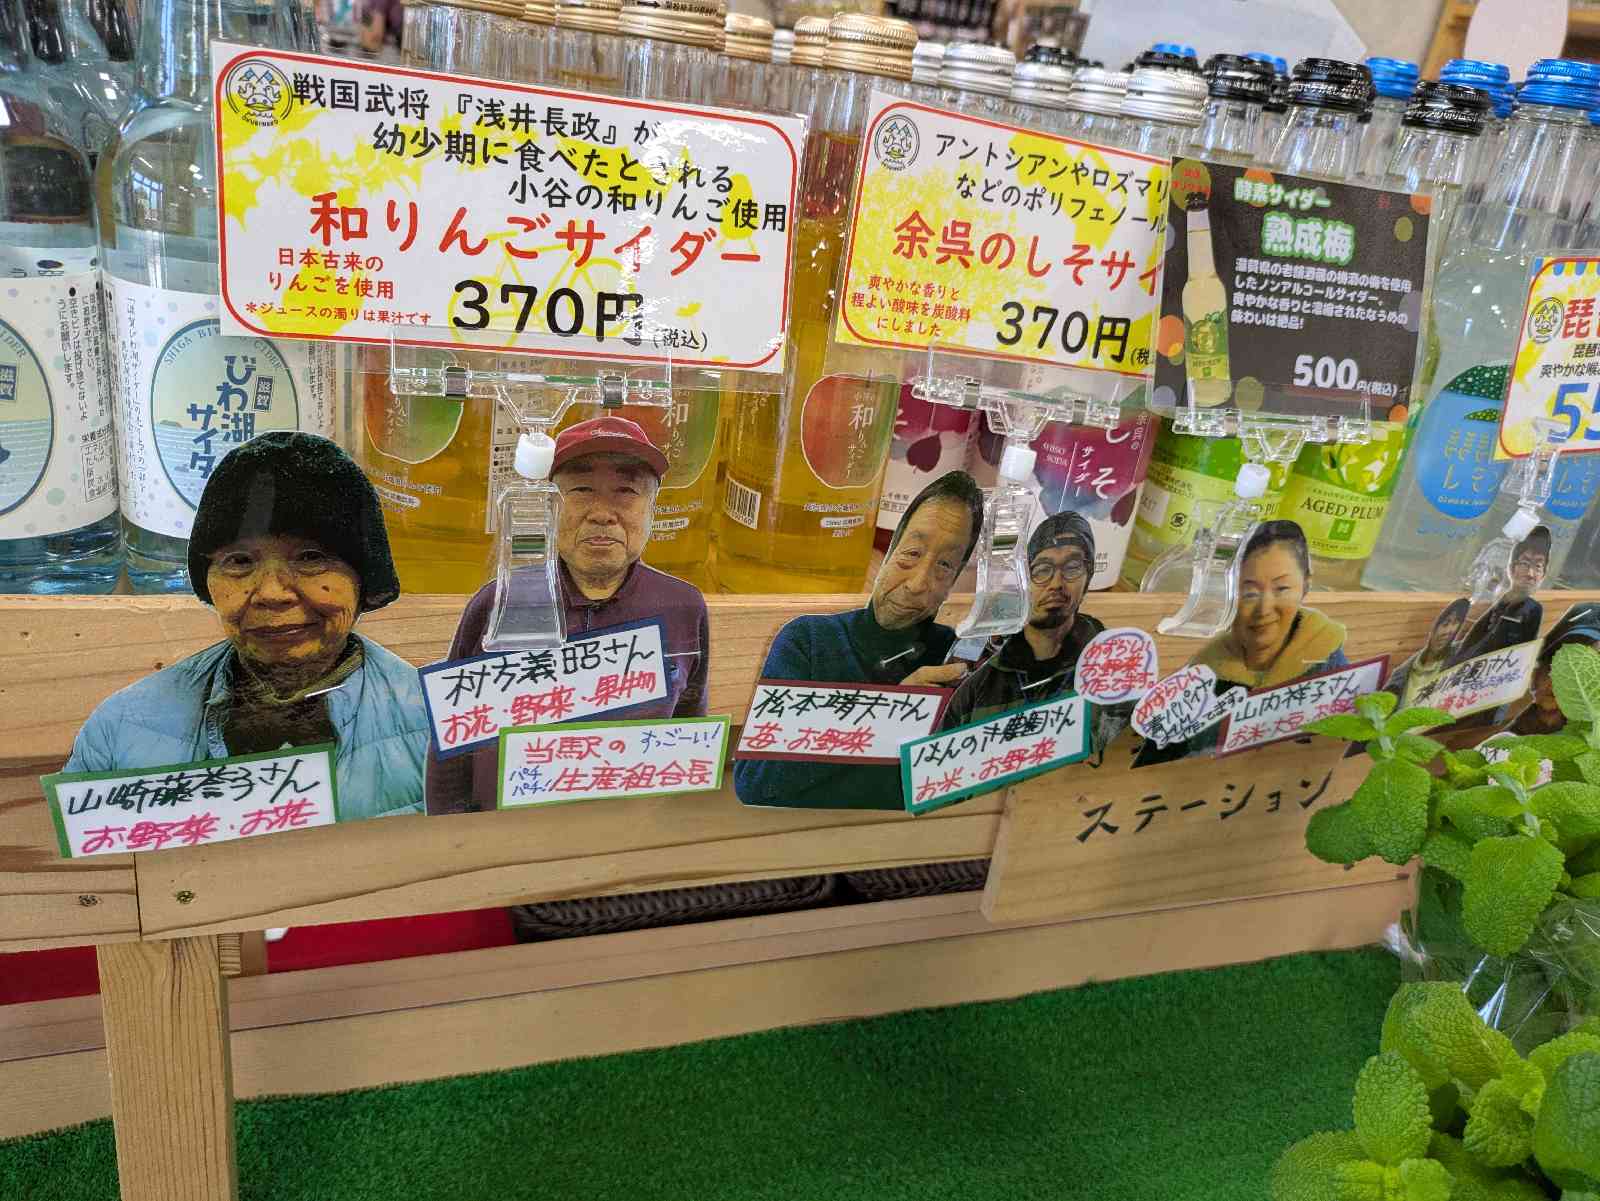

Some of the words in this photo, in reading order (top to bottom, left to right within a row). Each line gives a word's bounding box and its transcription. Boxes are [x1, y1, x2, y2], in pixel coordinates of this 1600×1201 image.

[292, 72, 430, 122] 戦国武将
[508, 177, 787, 233] 小谷の和りんご使用
[1234, 177, 1331, 210] 酵素サイダー
[310, 192, 761, 276] 和りんごサイダー
[892, 210, 1163, 296] 余呉のしそサイ
[1264, 213, 1355, 264] 熟成梅
[277, 247, 384, 274] 日本古来の
[268, 270, 394, 300] りんごを使用
[868, 274, 961, 302] 爽やかな香りと
[876, 316, 942, 337] にしました
[996, 300, 1131, 363] 370円
[1562, 298, 1600, 338] 琵
[1300, 496, 1348, 517] AGED
[442, 635, 655, 706] 村方義昭さん
[753, 688, 930, 725] 松本靖夫さん
[524, 736, 626, 765] 当駅の
[551, 759, 714, 792] 生産組合長
[1075, 767, 1334, 844] ステーション
